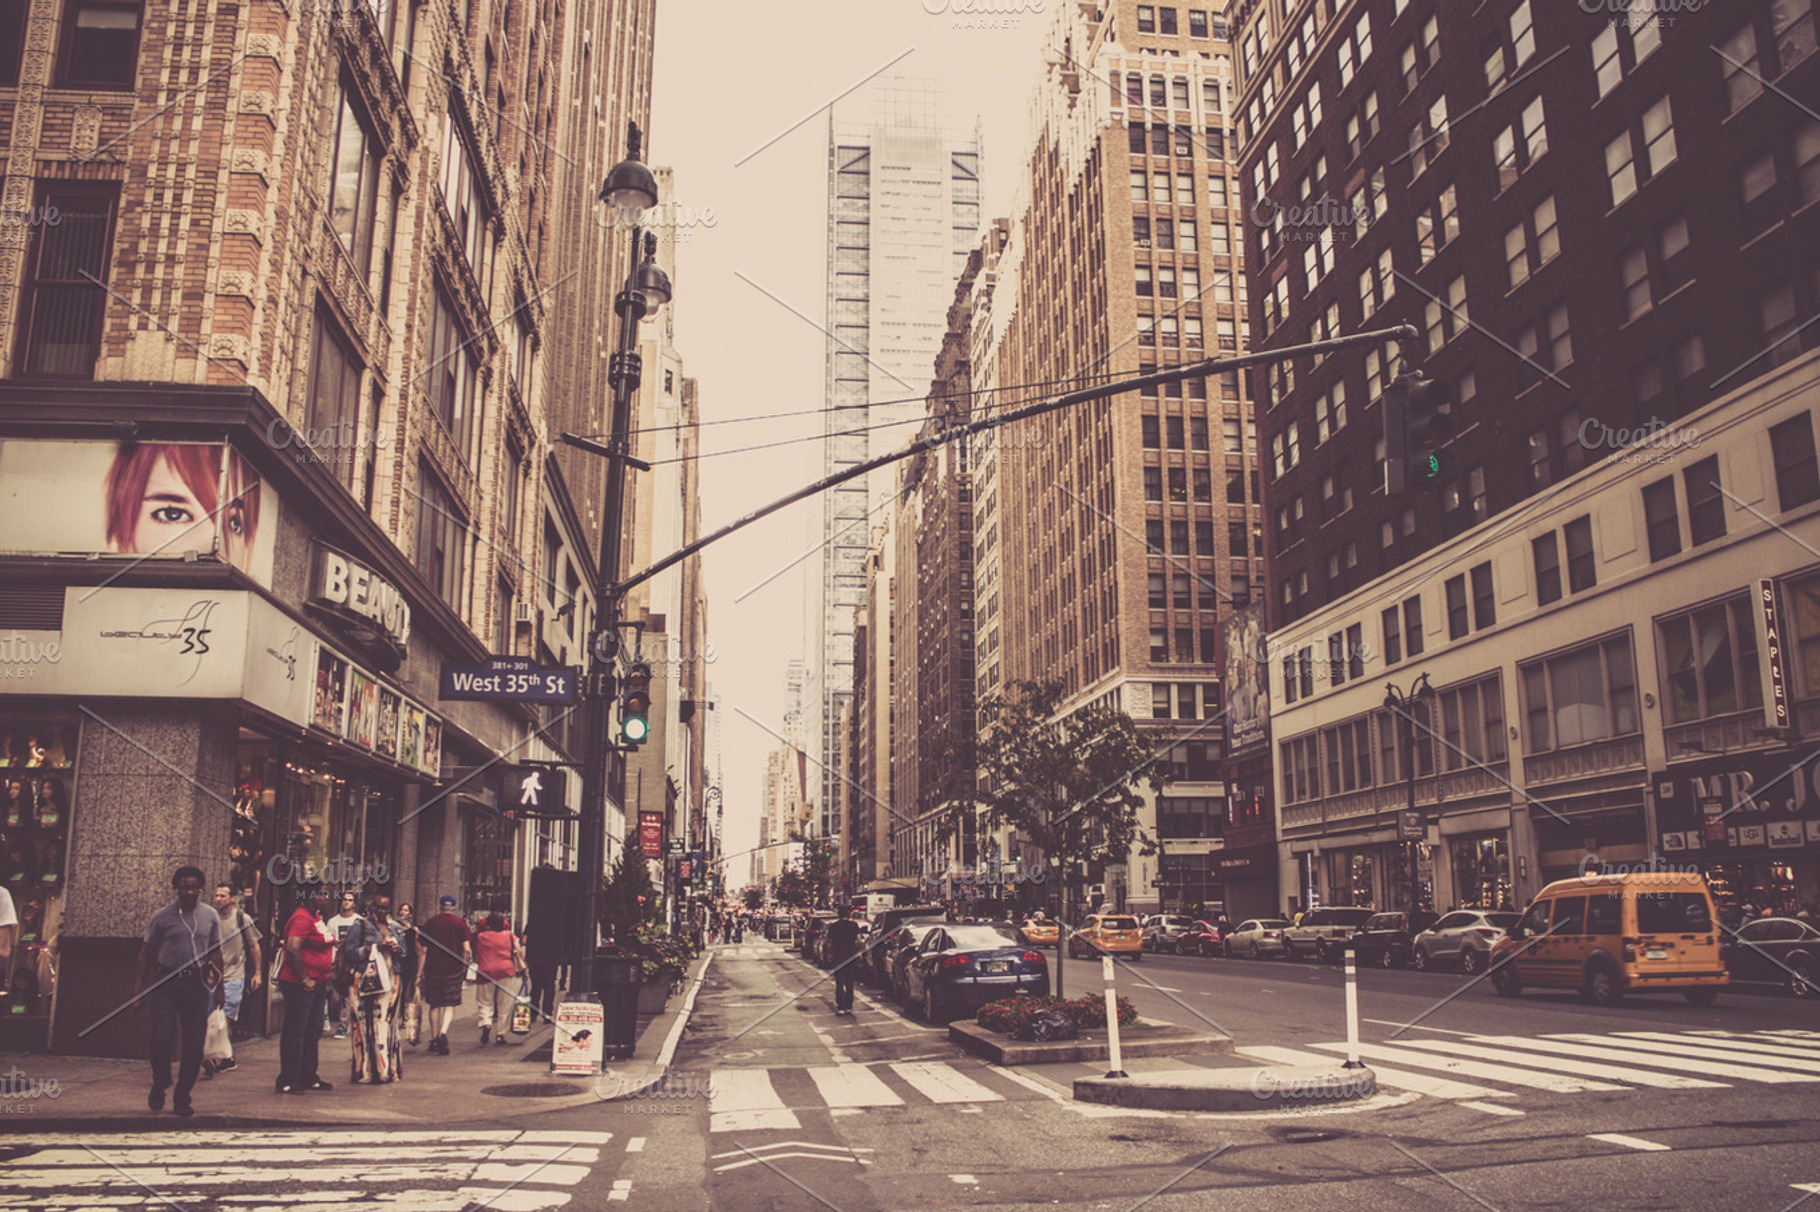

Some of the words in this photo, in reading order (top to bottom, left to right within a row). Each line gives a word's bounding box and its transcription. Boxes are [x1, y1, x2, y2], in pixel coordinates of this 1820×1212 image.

[179, 627, 212, 655] 35
[1763, 589, 1786, 717] STAPLES
[491, 661, 506, 670] 381
[514, 662, 528, 671] 301
[452, 672, 501, 692] West
[505, 673, 541, 693] 35th
[545, 675, 566, 694] St
[1688, 770, 1771, 816] MR.
[1786, 762, 1820, 812] J
